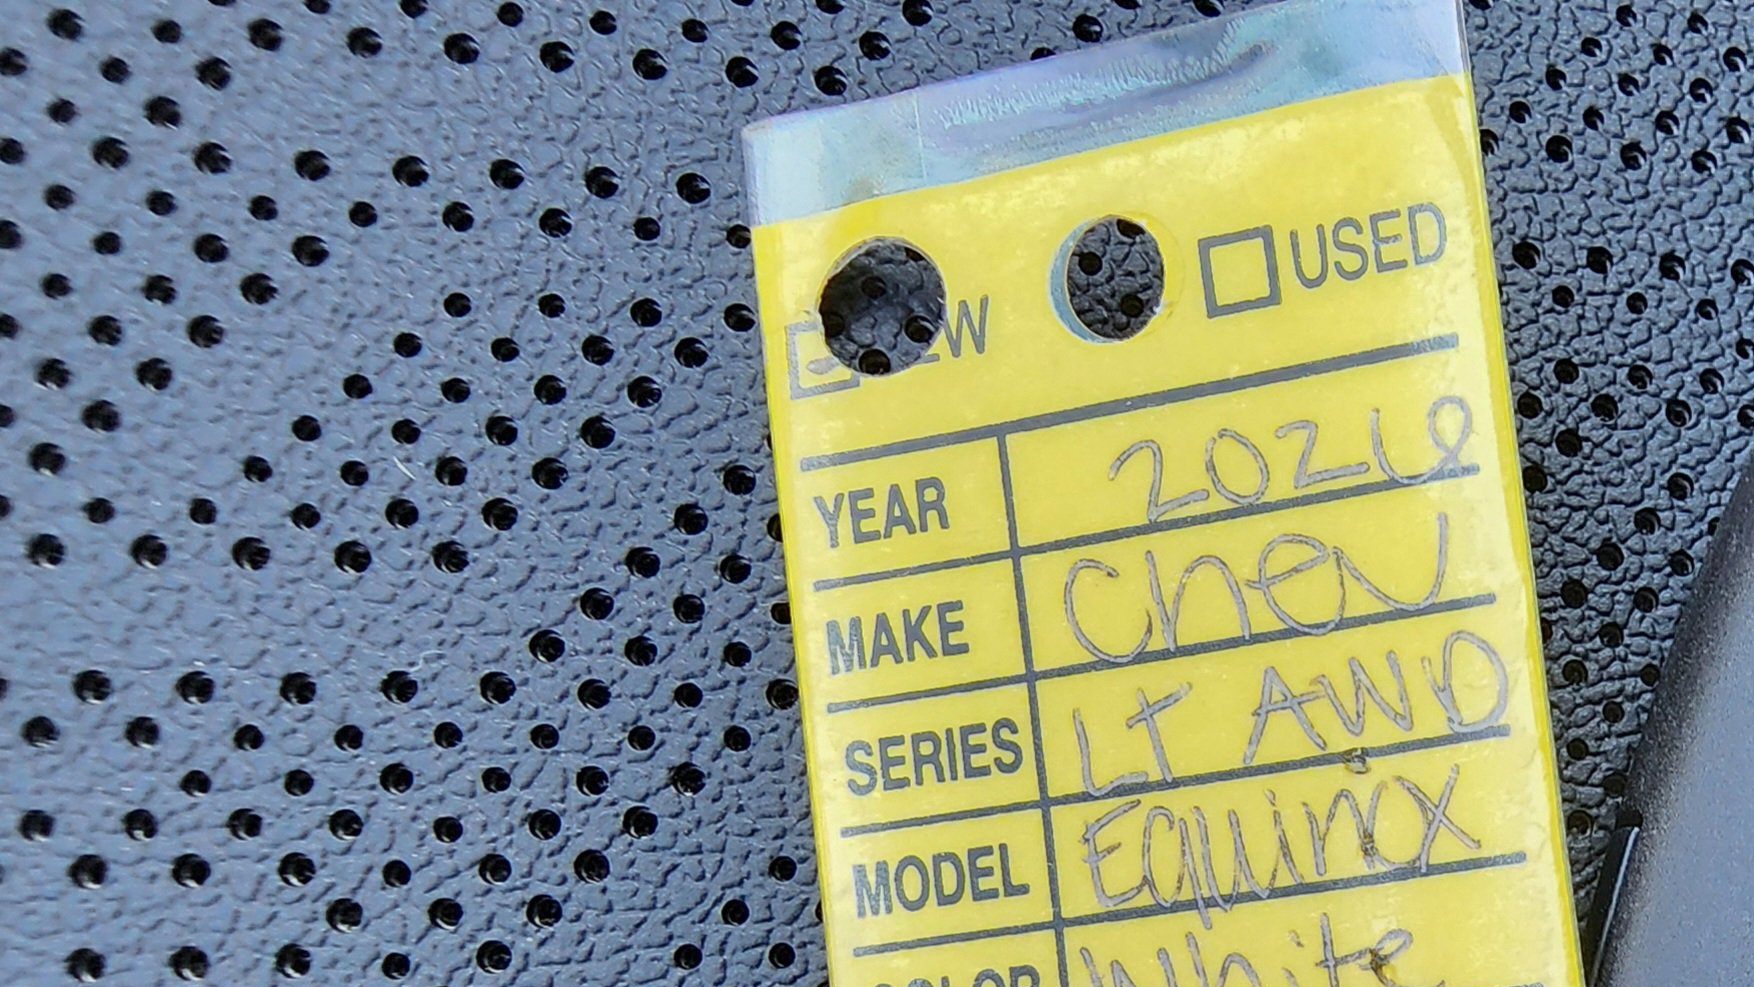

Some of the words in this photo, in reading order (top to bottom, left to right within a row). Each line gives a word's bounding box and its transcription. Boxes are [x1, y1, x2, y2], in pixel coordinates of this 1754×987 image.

[1289, 201, 1449, 289] USED
[1108, 395, 1475, 524] 2026
[812, 475, 951, 549] YEAR
[825, 600, 971, 678] MAKE
[1073, 679, 1192, 799] LT
[1242, 628, 1510, 766] AWD
[845, 717, 1024, 798] SERIES
[852, 844, 1031, 919] MODEL
[1081, 763, 1482, 930] Equinox
